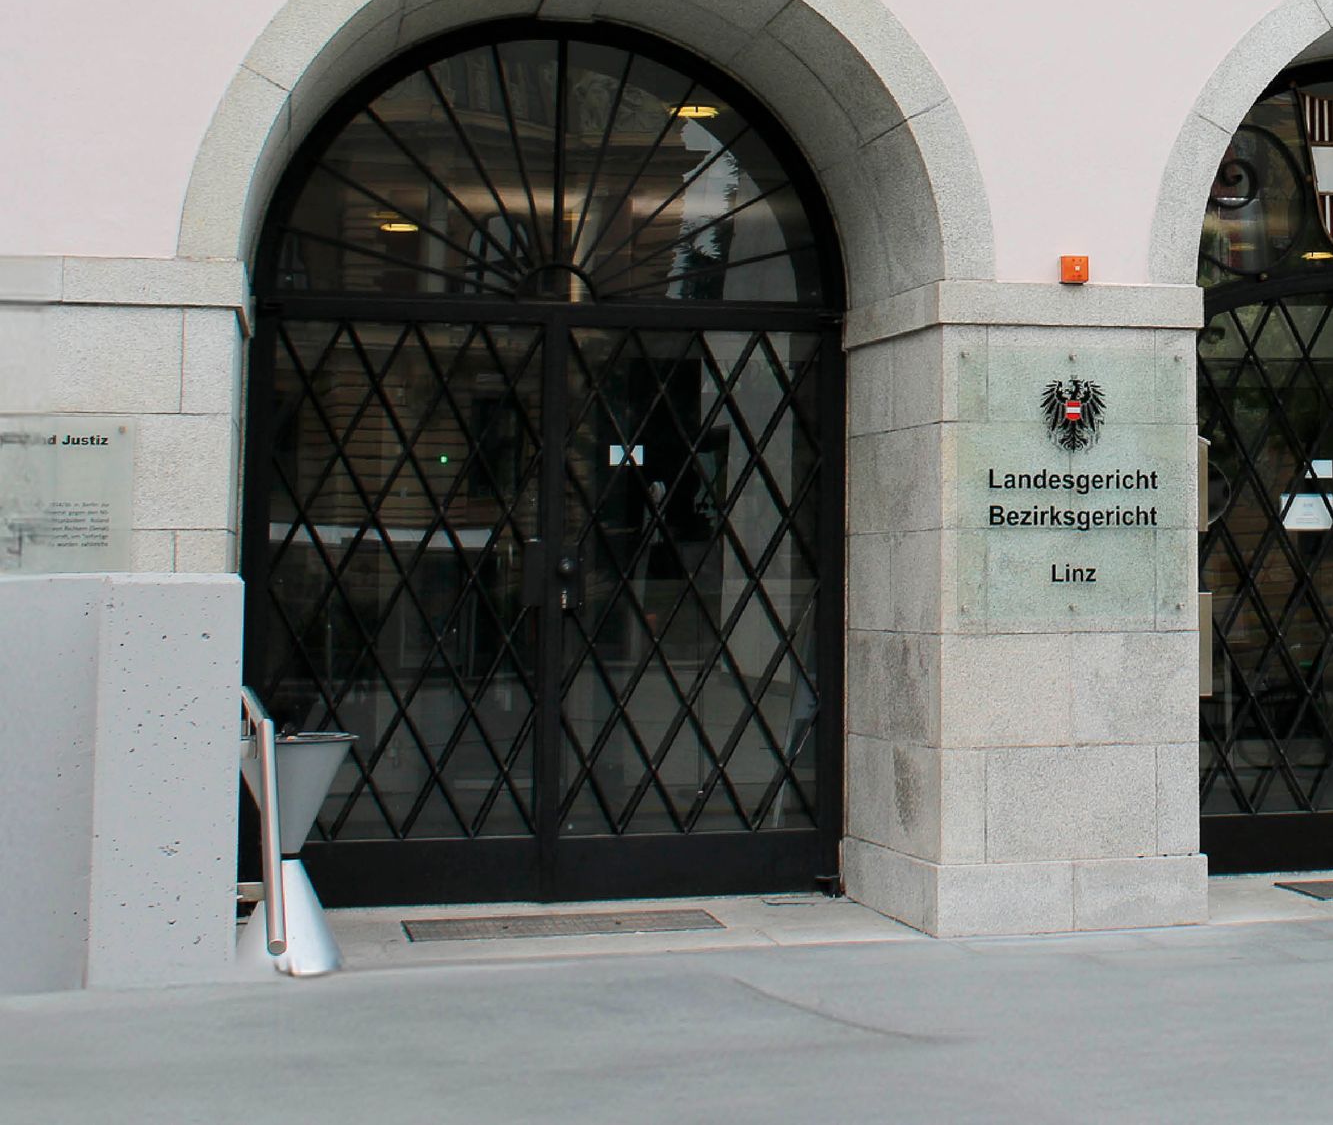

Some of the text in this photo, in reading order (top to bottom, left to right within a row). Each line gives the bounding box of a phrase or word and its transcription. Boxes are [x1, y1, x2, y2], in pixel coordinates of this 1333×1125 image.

[62, 434, 109, 446] Justiz
[988, 468, 1159, 495] Landesgericht
[989, 505, 1158, 531] Bezirksgericht
[1051, 563, 1097, 583] Linz
